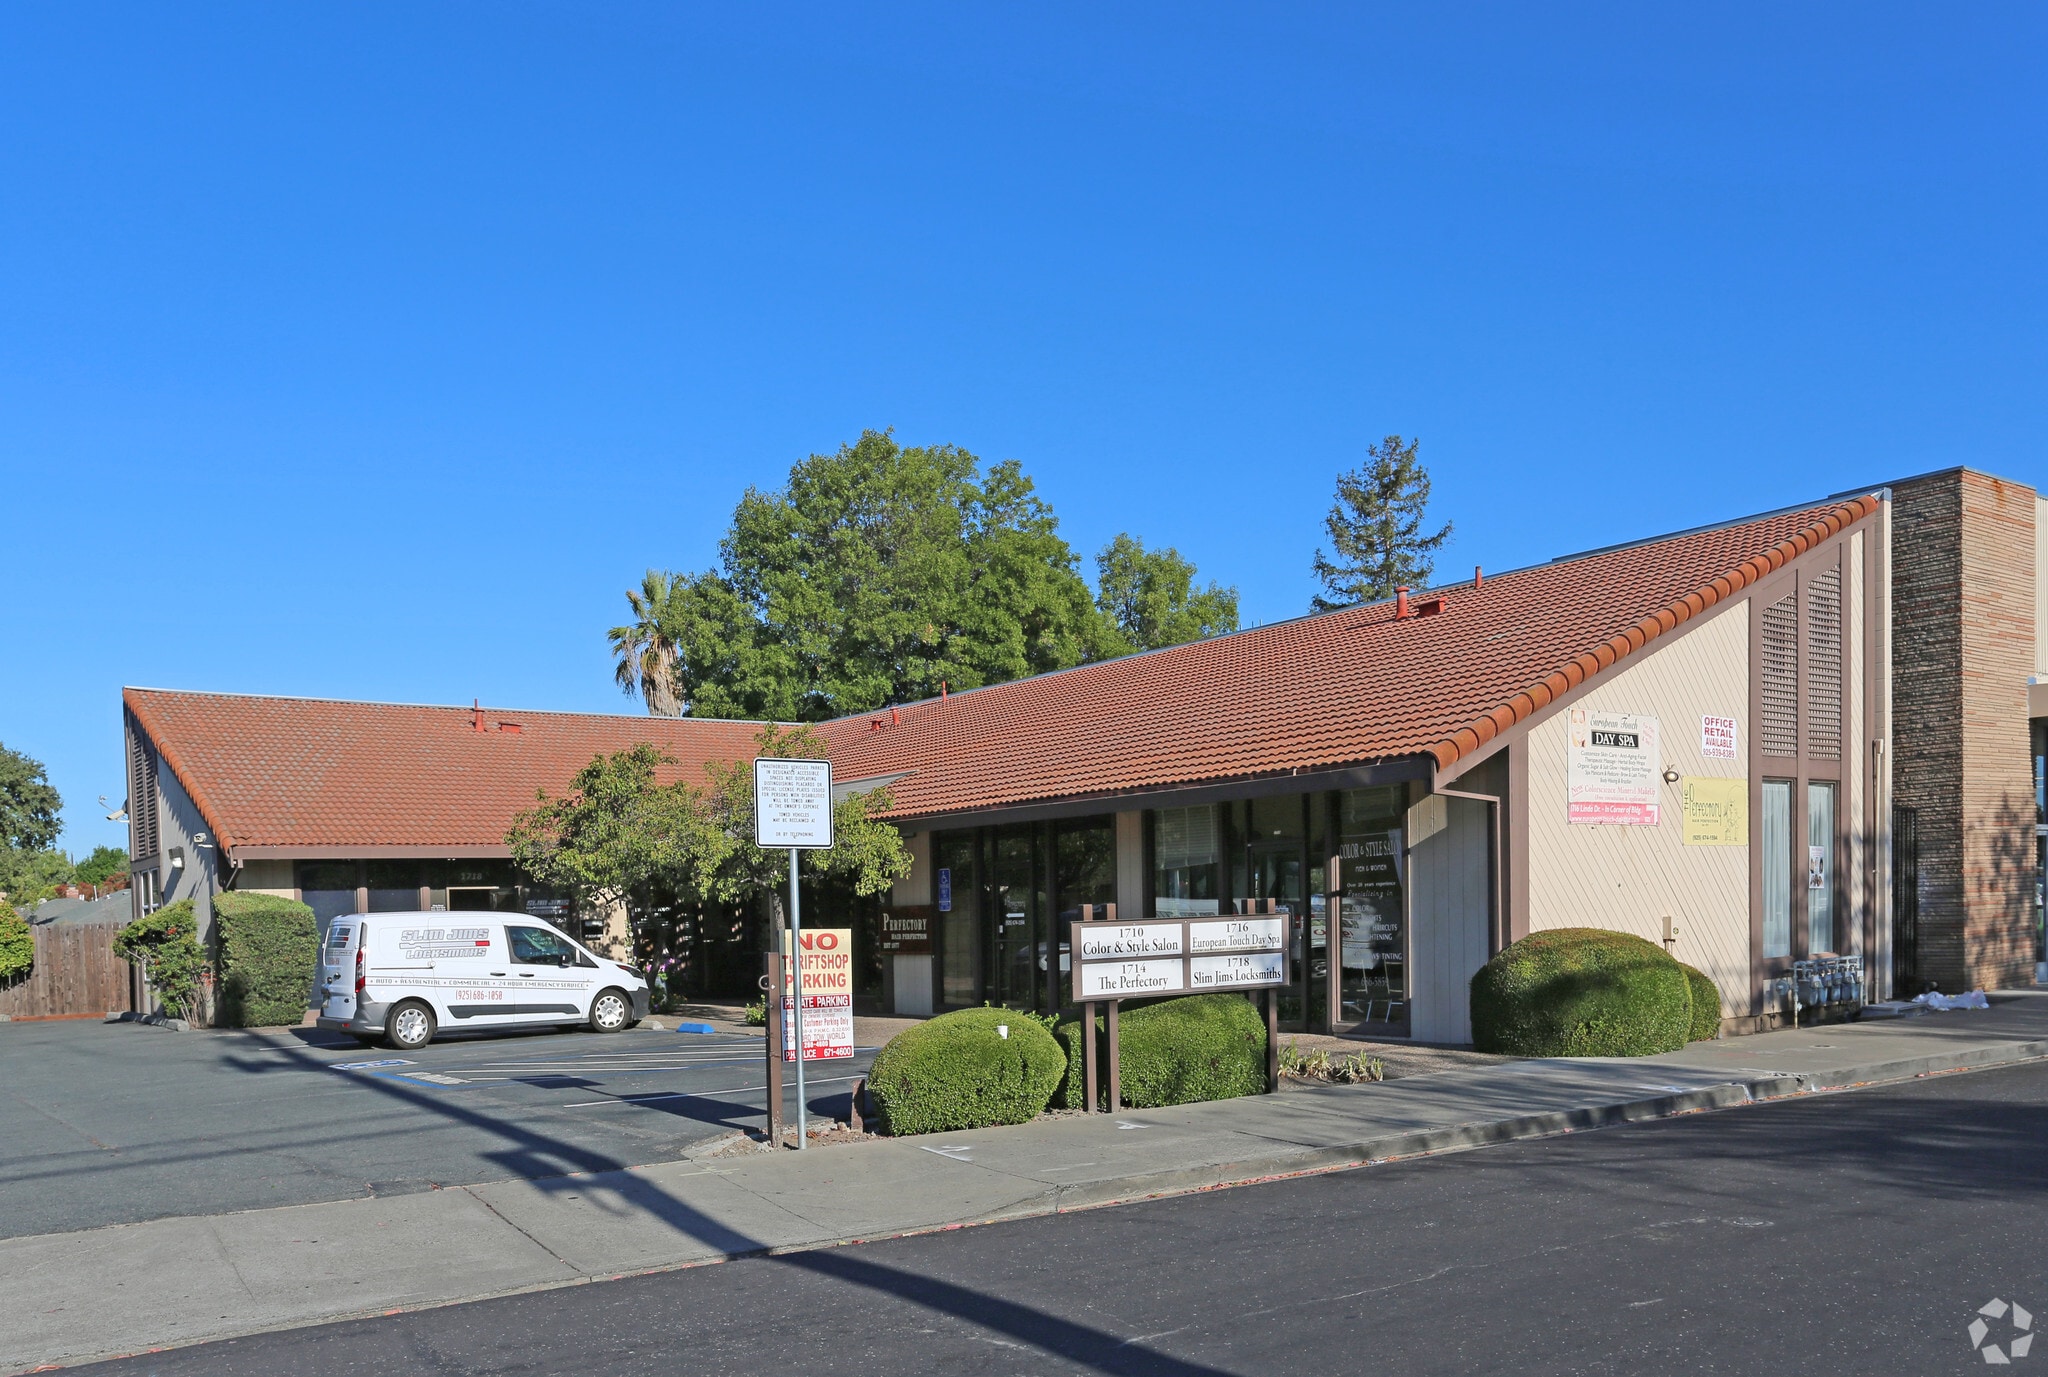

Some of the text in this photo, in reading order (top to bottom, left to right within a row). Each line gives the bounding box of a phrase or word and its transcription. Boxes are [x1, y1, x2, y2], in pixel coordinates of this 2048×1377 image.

[1590, 714, 1638, 730] European Touch
[1704, 717, 1733, 728] OFFICE
[1704, 727, 1733, 738] RETAIL
[1596, 733, 1635, 746] DAY SPA
[1706, 738, 1732, 748] AVAILABLE
[1626, 807, 1631, 815] of
[1340, 843, 1359, 859] COLOR
[1360, 846, 1364, 855] &
[1366, 841, 1382, 857] STYLE
[883, 913, 927, 930] PERFECTORY
[1227, 922, 1248, 932] 1716
[402, 928, 489, 940] SLIM JIMS
[1120, 928, 1144, 938] 1710
[799, 933, 838, 951] NO
[1084, 941, 1111, 955] Color
[1114, 941, 1124, 953] &
[1127, 939, 1149, 956] Style
[1152, 938, 1178, 951] Salon
[1193, 937, 1226, 950] European
[1229, 934, 1250, 946] Touch
[1252, 934, 1266, 945] Day
[1268, 933, 1280, 947] Spa
[406, 948, 487, 959] LOCKSMITHS
[1122, 962, 1146, 974] 1714
[1228, 958, 1250, 967] 1718
[785, 973, 846, 989] PRKING
[1099, 974, 1168, 990] The Perfectory
[1194, 967, 1280, 985] Slim Jims Locksmiths
[817, 996, 848, 1007] PARKING
[804, 1019, 823, 1027] Customer
[824, 1018, 839, 1026] Parking
[840, 1017, 848, 1026] Only
[824, 1047, 851, 1057] 671-4600
